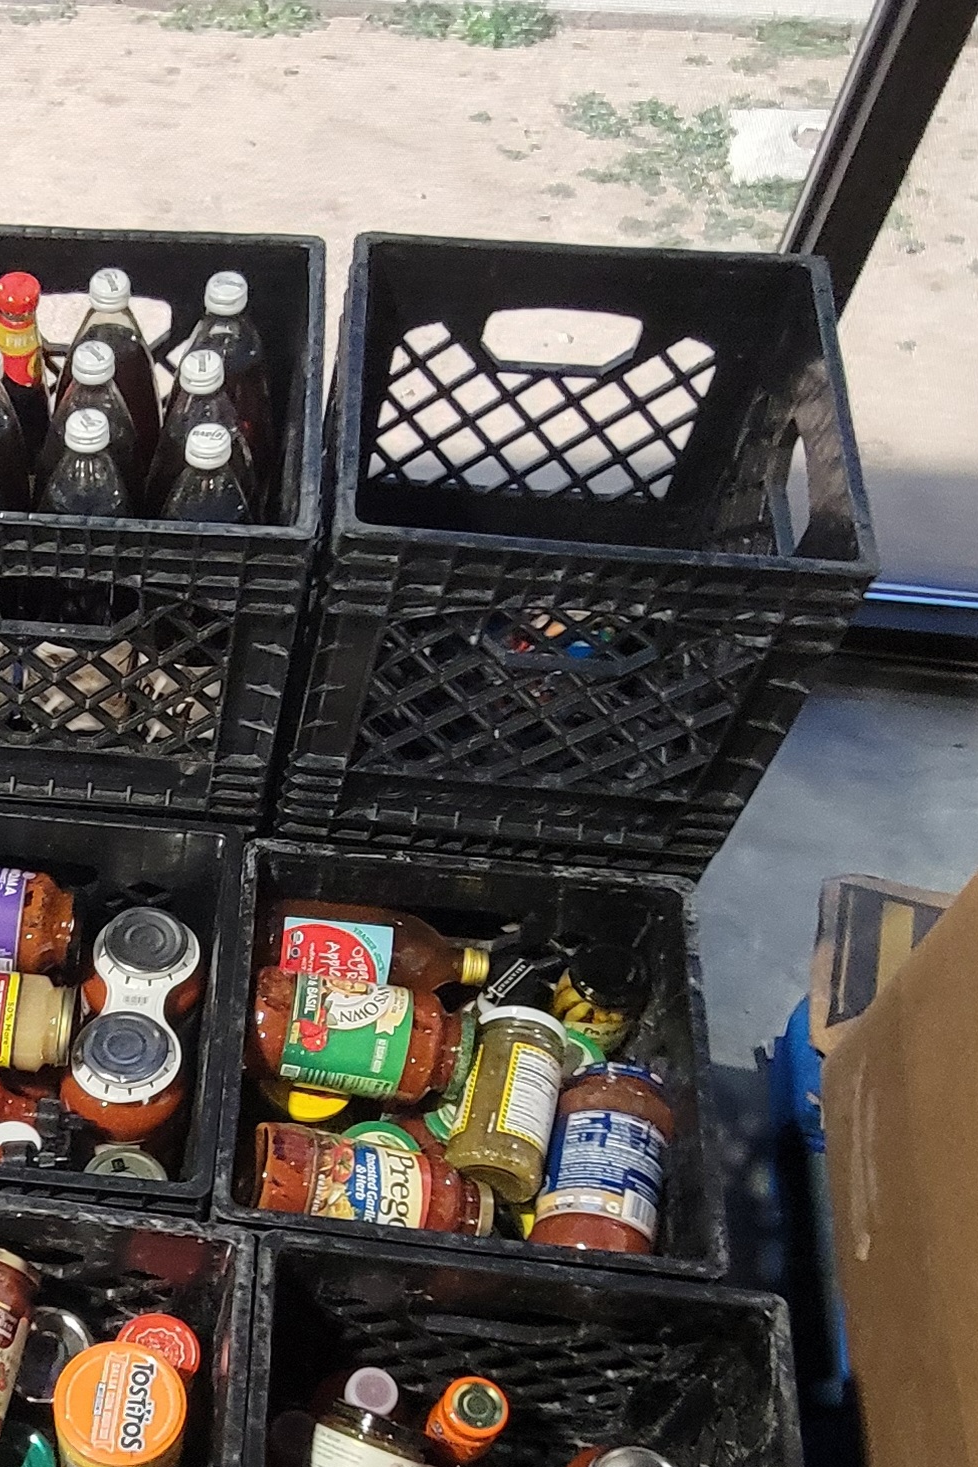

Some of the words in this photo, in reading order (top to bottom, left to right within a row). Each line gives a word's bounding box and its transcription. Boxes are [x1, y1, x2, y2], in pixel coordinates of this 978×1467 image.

[318, 940, 344, 978] Apple
[5, 1001, 14, 1021] 50%
[303, 986, 317, 1014] BASIL
[337, 1001, 377, 1023] OWN
[356, 1164, 365, 1174] &
[365, 1152, 376, 1190] Roasted
[355, 1173, 364, 1200] Herb
[363, 1190, 377, 1223] Garlic
[108, 1362, 120, 1389] SALSA
[121, 1363, 155, 1449] TOSTITOS
